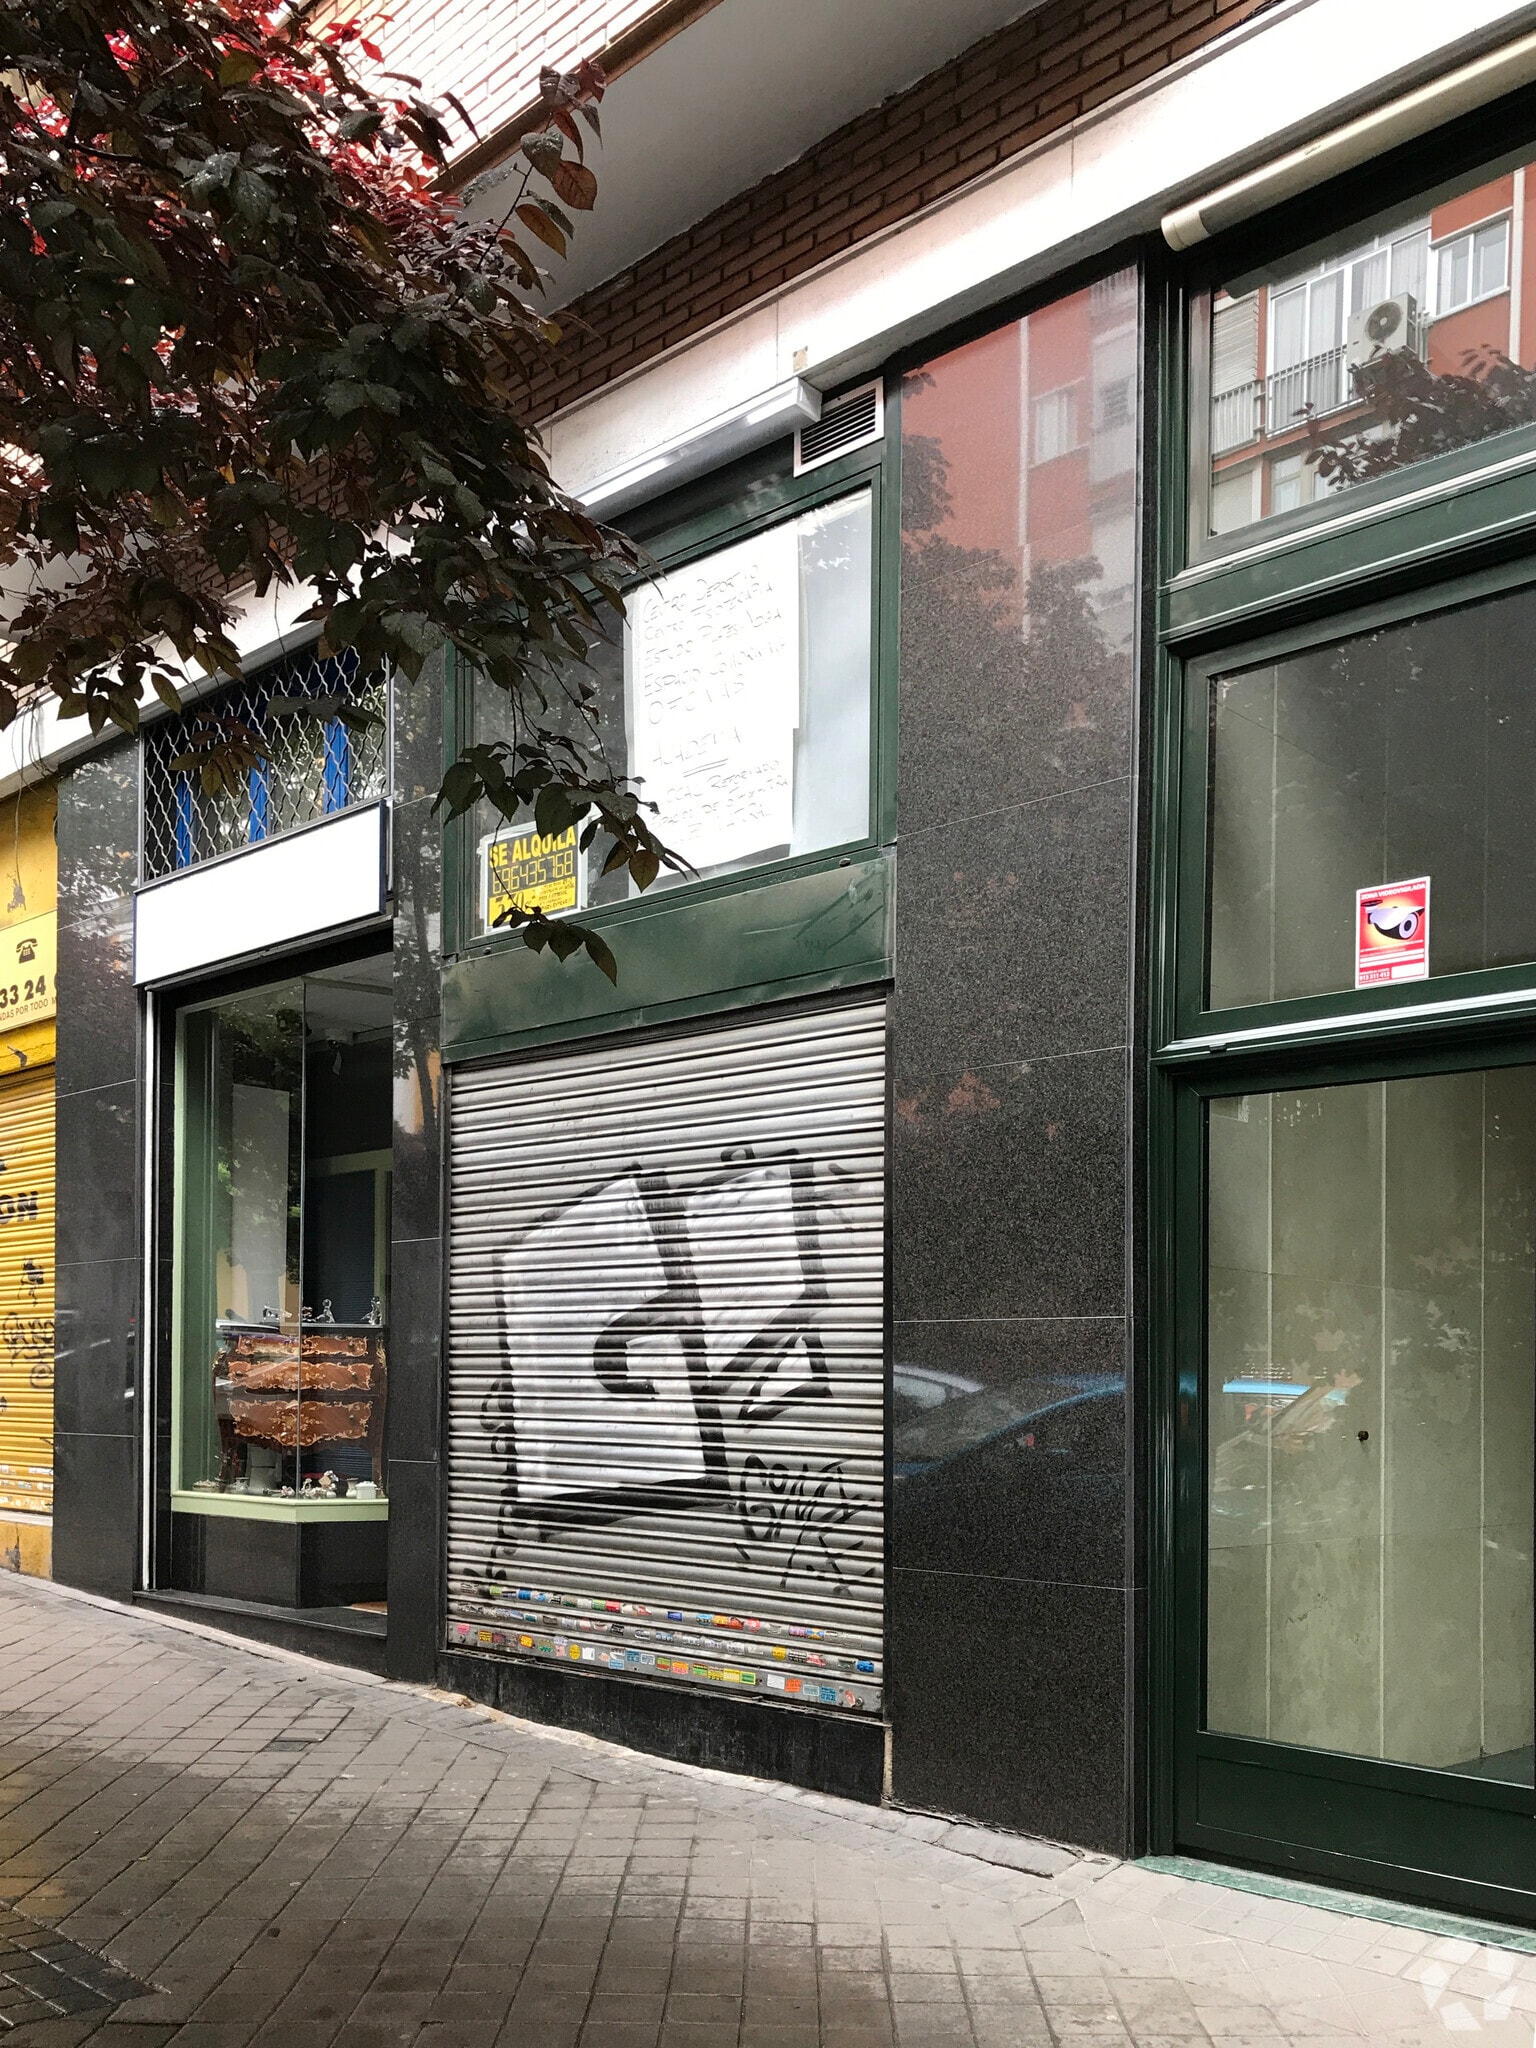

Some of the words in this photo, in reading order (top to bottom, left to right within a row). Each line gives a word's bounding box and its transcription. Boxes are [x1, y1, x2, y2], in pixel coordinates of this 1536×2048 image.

[489, 843, 508, 869] SE
[24, 975, 46, 1001] 24
[15, 1004, 29, 1017] POR
[30, 998, 49, 1012] TODO
